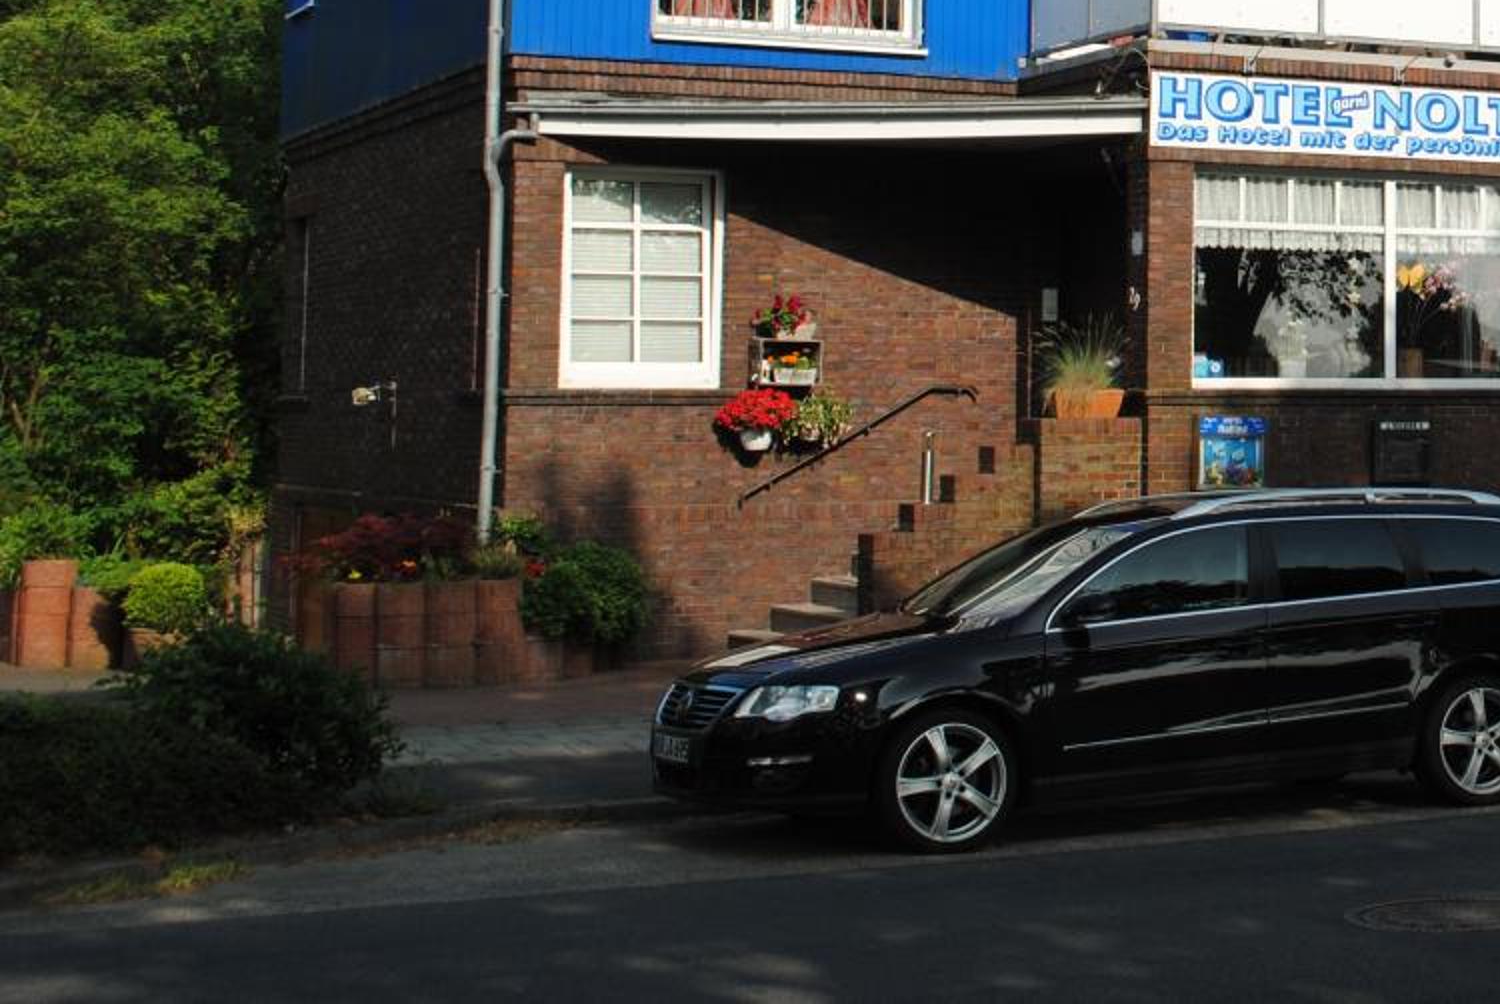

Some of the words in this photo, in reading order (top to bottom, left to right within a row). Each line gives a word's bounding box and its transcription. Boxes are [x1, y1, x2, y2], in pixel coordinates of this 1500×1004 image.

[1159, 76, 1352, 128] HOTEL
[1331, 92, 1368, 114] garni
[1157, 122, 1208, 142] Das
[1218, 126, 1291, 146] Hotel
[1299, 130, 1347, 148] mit
[1354, 130, 1399, 151] der
